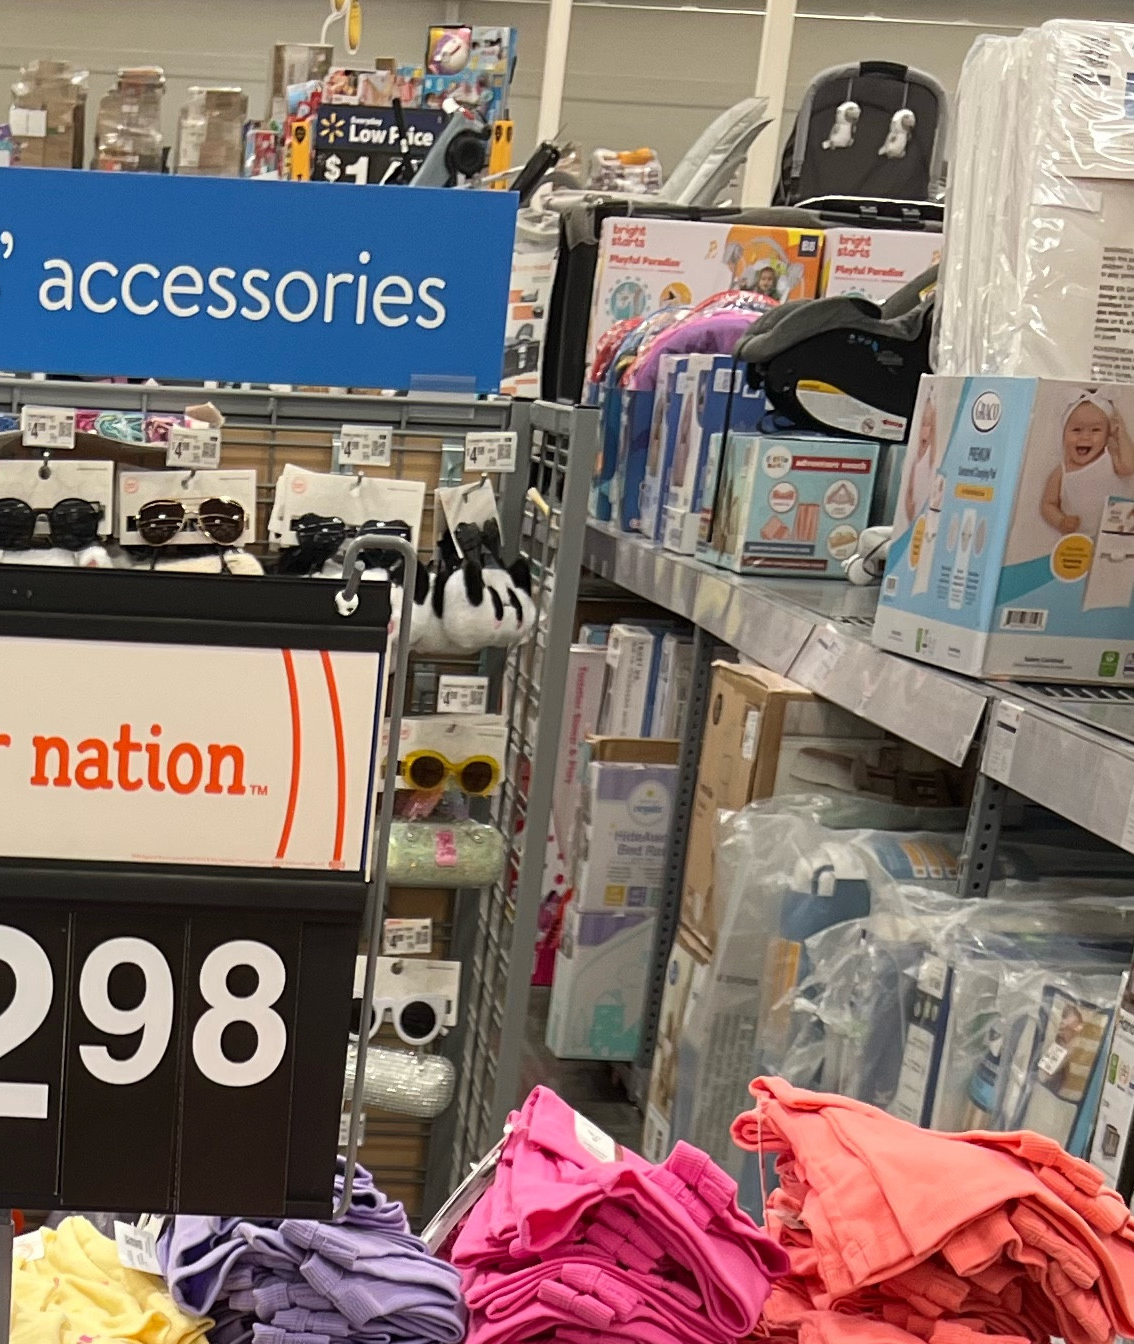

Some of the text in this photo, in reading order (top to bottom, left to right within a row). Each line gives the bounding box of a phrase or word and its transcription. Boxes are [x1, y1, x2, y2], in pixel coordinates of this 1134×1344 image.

[349, 124, 434, 147] Low Pice
[39, 251, 447, 330] accessories
[29, 724, 248, 795] nation
